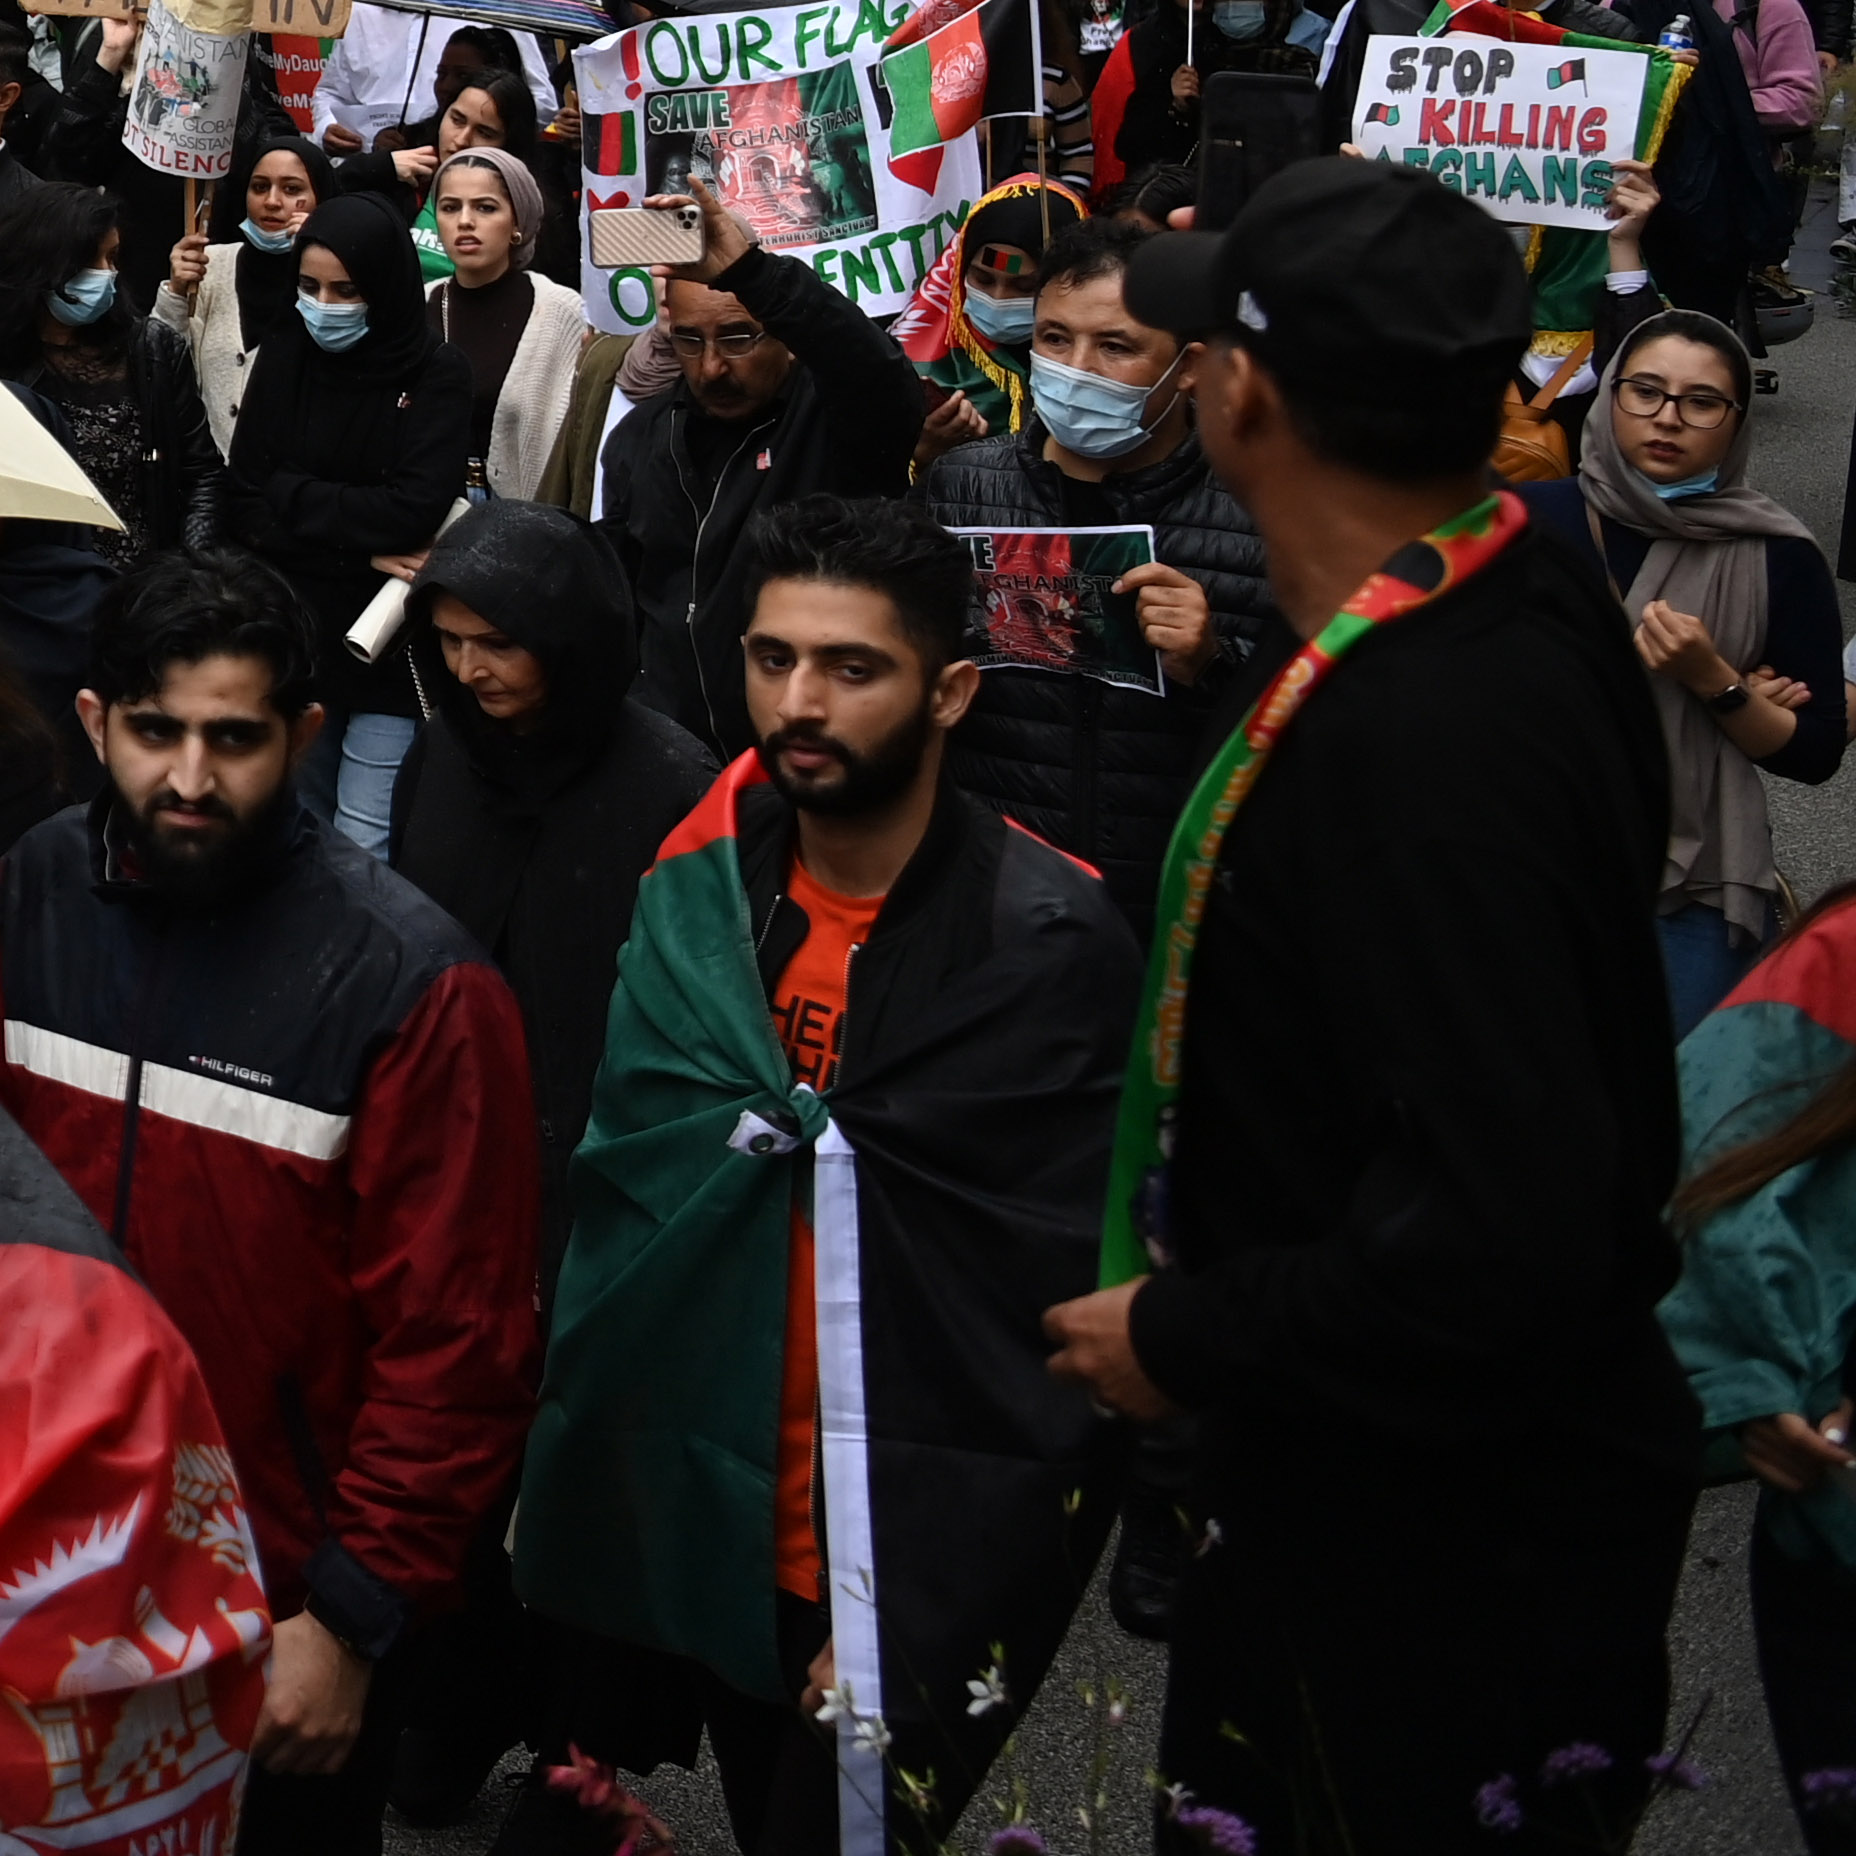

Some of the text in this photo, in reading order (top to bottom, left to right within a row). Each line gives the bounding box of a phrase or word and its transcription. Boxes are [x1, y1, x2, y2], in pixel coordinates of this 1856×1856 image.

[645, 16, 784, 87] OUR
[1385, 46, 1515, 96] STOP
[182, 117, 235, 134] GLOBA
[648, 89, 732, 134] SAVE
[697, 103, 862, 150] AFGHANISTAN
[1417, 97, 1608, 158] KILLING
[141, 136, 232, 174] SILENC
[167, 131, 232, 151] ASSISTAN
[201, 1055, 273, 1086] HILFIGER
